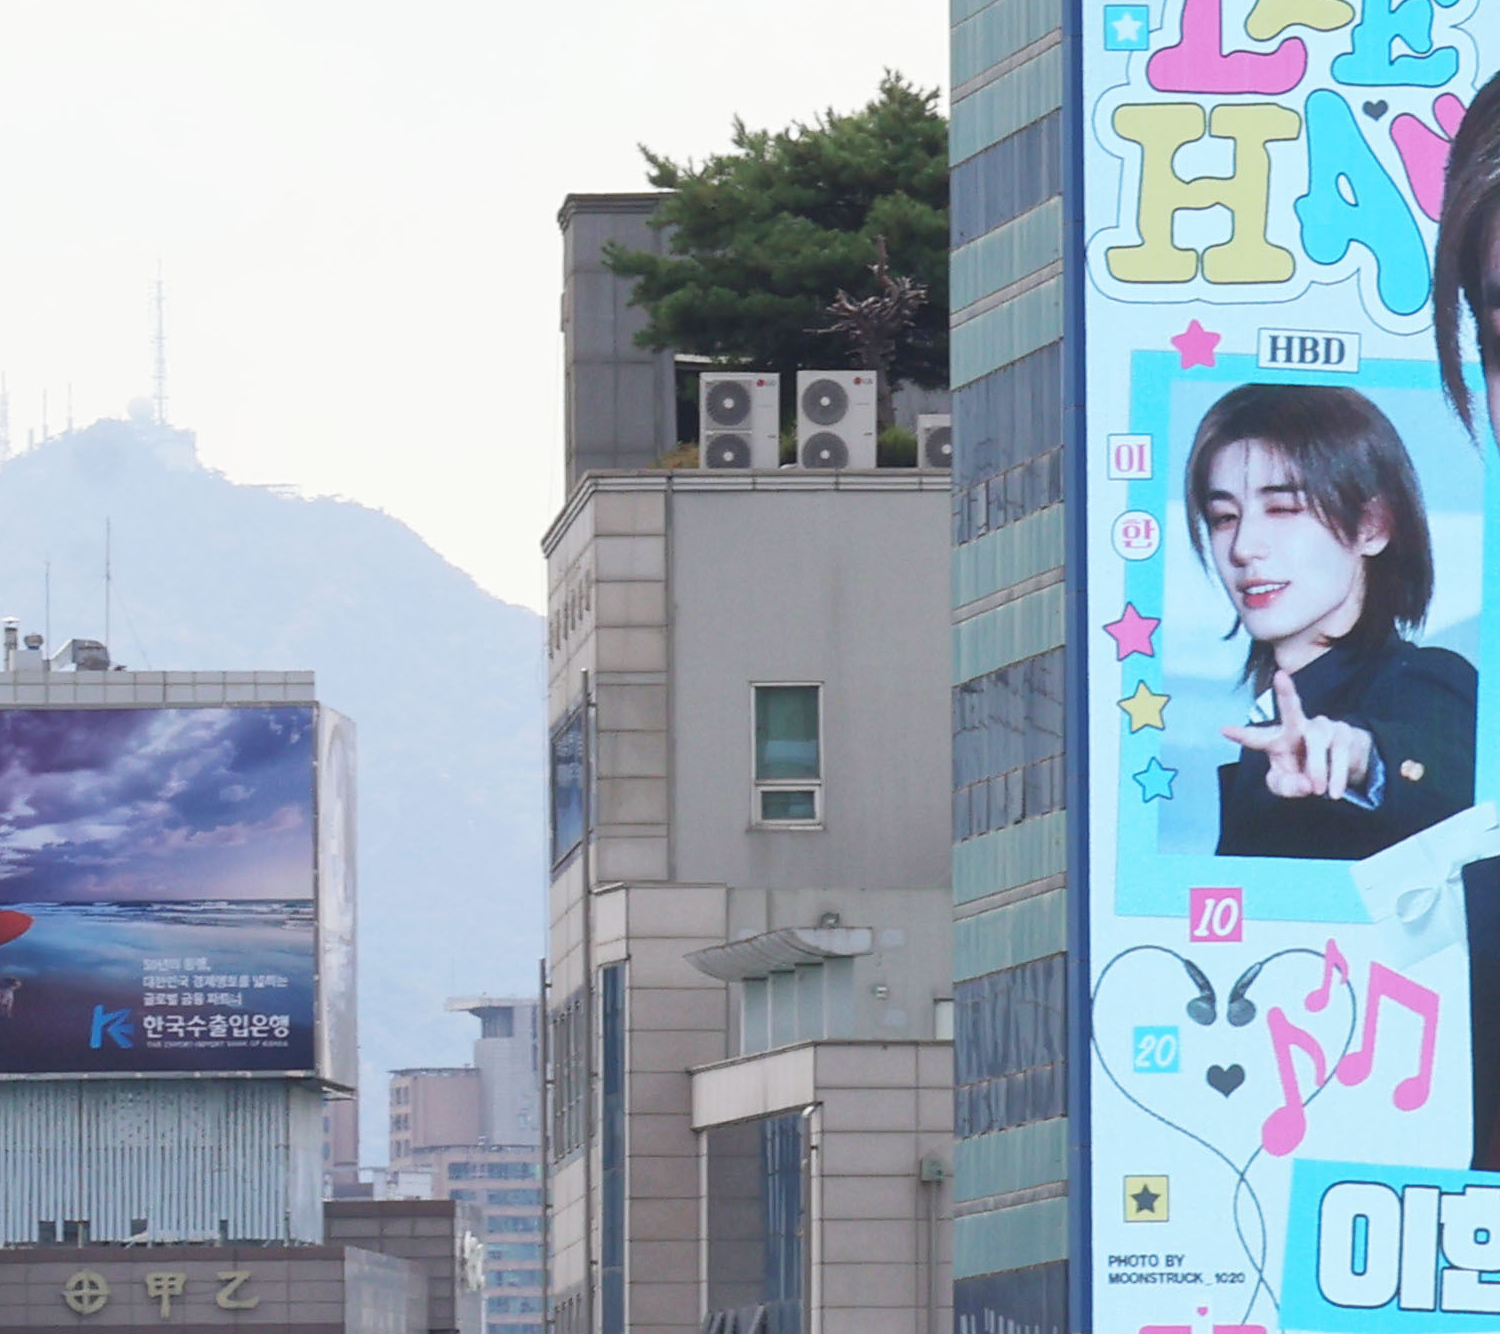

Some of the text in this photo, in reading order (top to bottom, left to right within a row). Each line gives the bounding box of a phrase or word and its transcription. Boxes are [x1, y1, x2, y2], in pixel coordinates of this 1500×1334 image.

[1267, 335, 1346, 366] HBD
[1122, 518, 1156, 549] 한
[1193, 897, 1239, 937] 10
[143, 1014, 290, 1039] 한국수출입은행
[1134, 1034, 1177, 1068] 20
[1108, 1254, 1185, 1267] PHOTO BY
